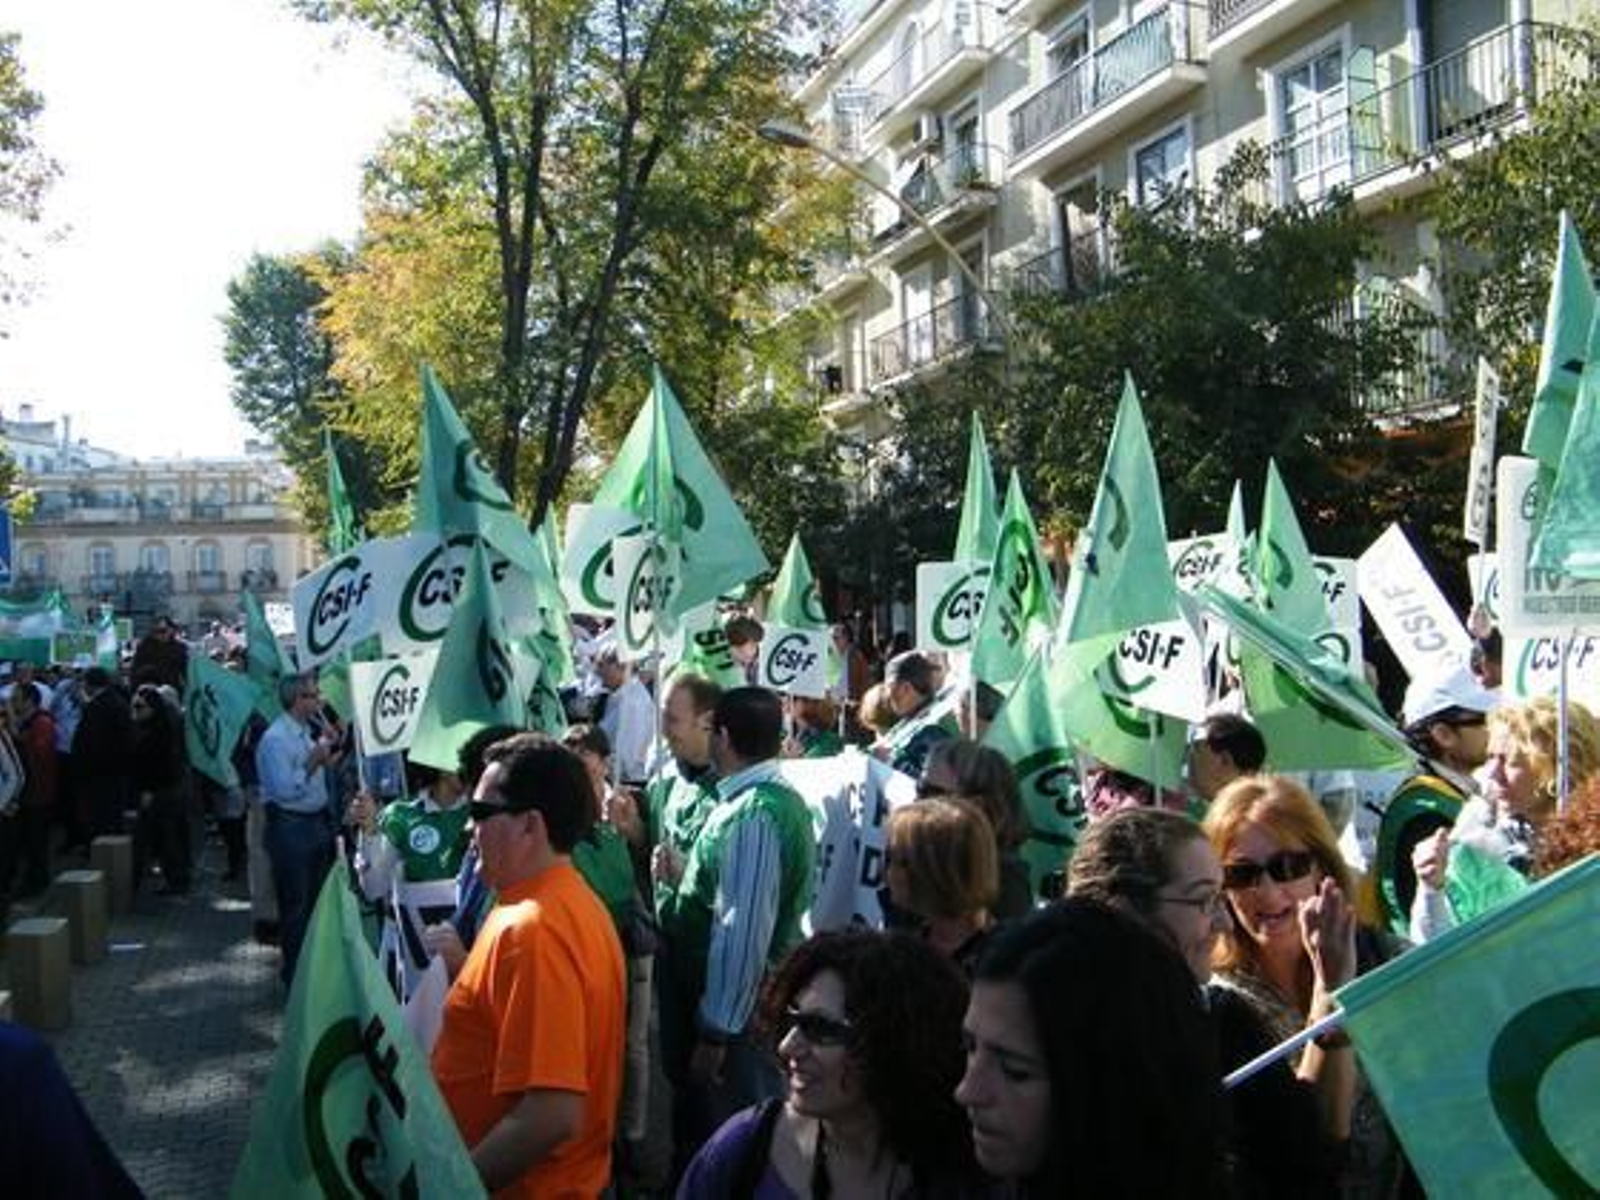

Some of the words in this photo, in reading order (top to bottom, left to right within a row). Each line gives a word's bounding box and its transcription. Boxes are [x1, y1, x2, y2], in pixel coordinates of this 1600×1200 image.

[318, 571, 372, 627] CSI-F
[1381, 585, 1448, 652] CSI-F
[775, 647, 818, 673] CSI-F
[1119, 628, 1186, 671] CSI-F
[380, 686, 420, 718] CSI-F
